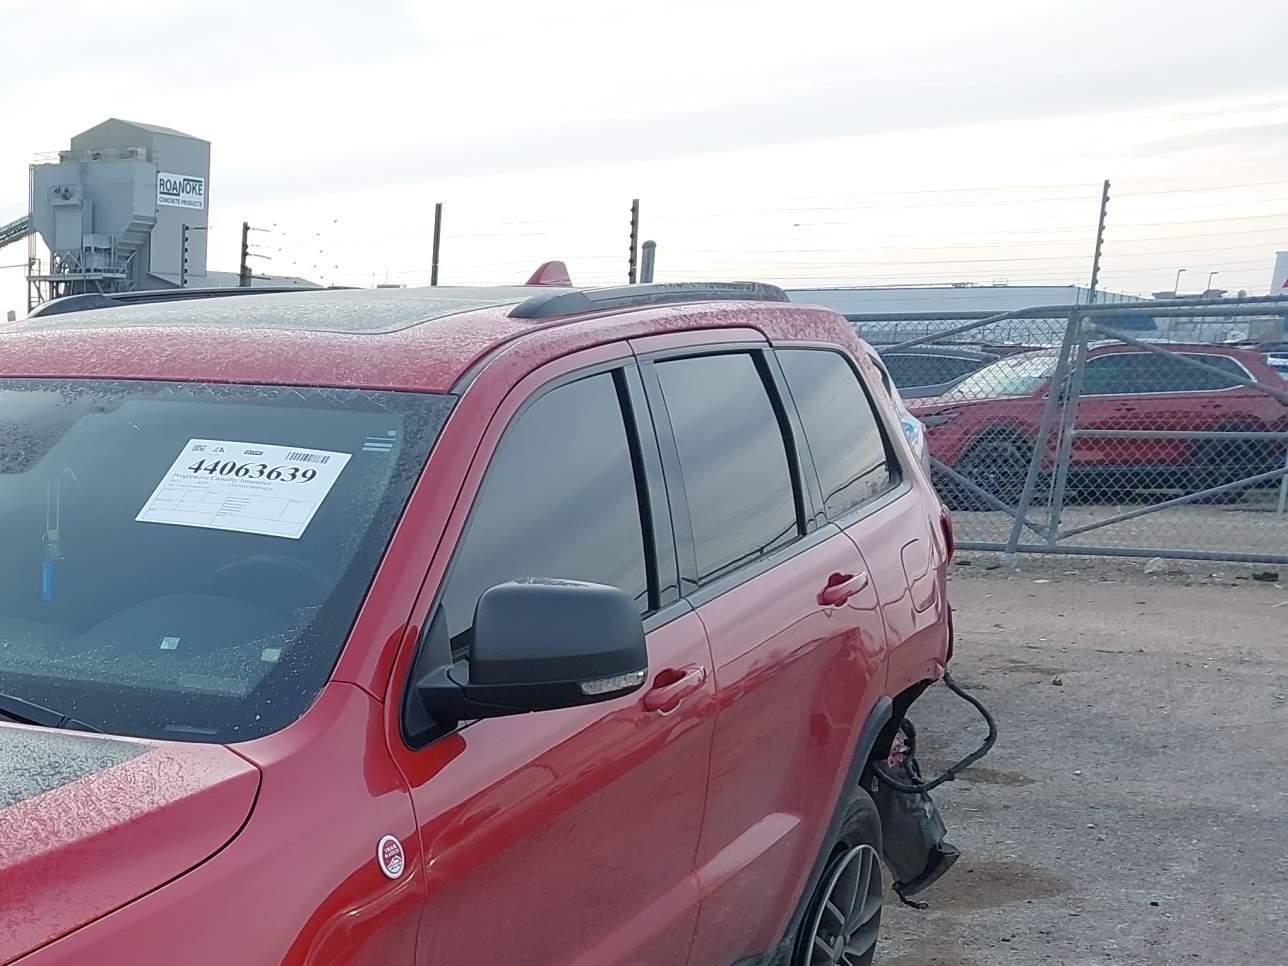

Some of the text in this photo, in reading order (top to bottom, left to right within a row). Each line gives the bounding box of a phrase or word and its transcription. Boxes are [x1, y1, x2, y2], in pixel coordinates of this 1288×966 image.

[159, 178, 203, 196] ROANOKE
[159, 195, 180, 205] CONCRETE
[188, 458, 318, 484] 44063639
